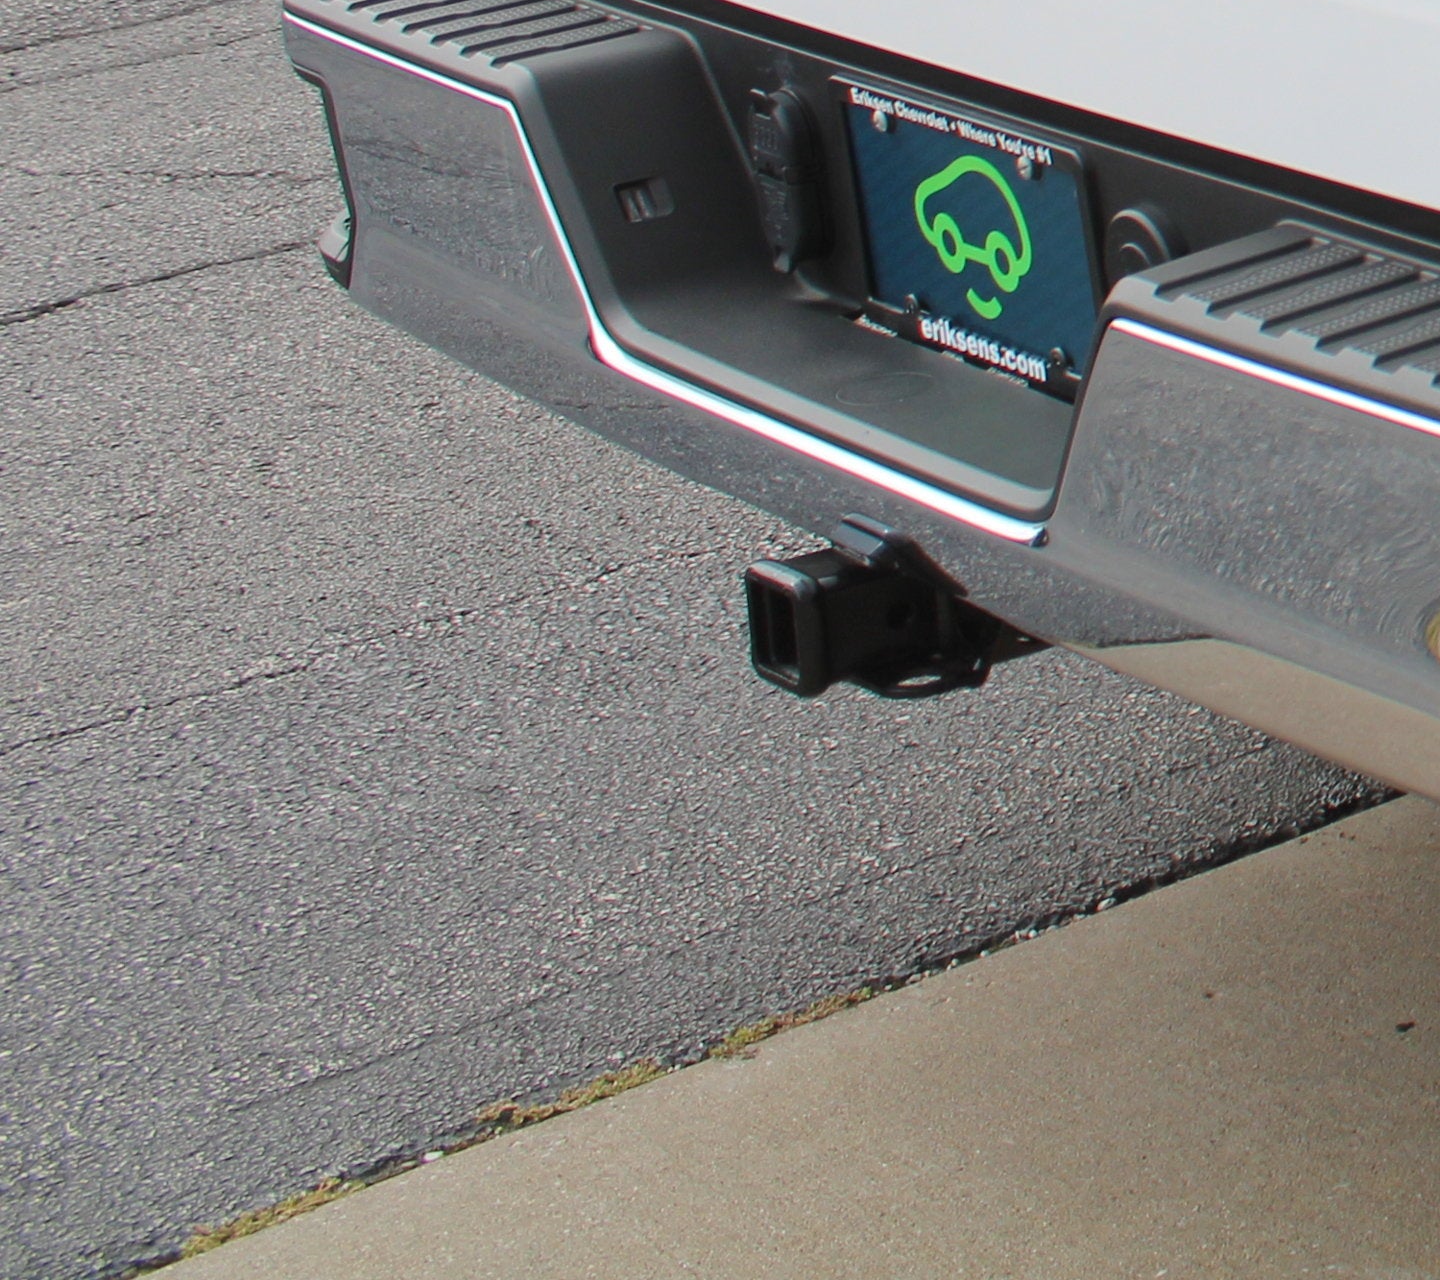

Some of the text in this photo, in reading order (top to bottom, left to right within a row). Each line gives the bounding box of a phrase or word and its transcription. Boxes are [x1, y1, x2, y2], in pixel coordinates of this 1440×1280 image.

[850, 87, 895, 115] Eriksen
[957, 119, 997, 148] Where
[920, 316, 1047, 383] eriksens.com
